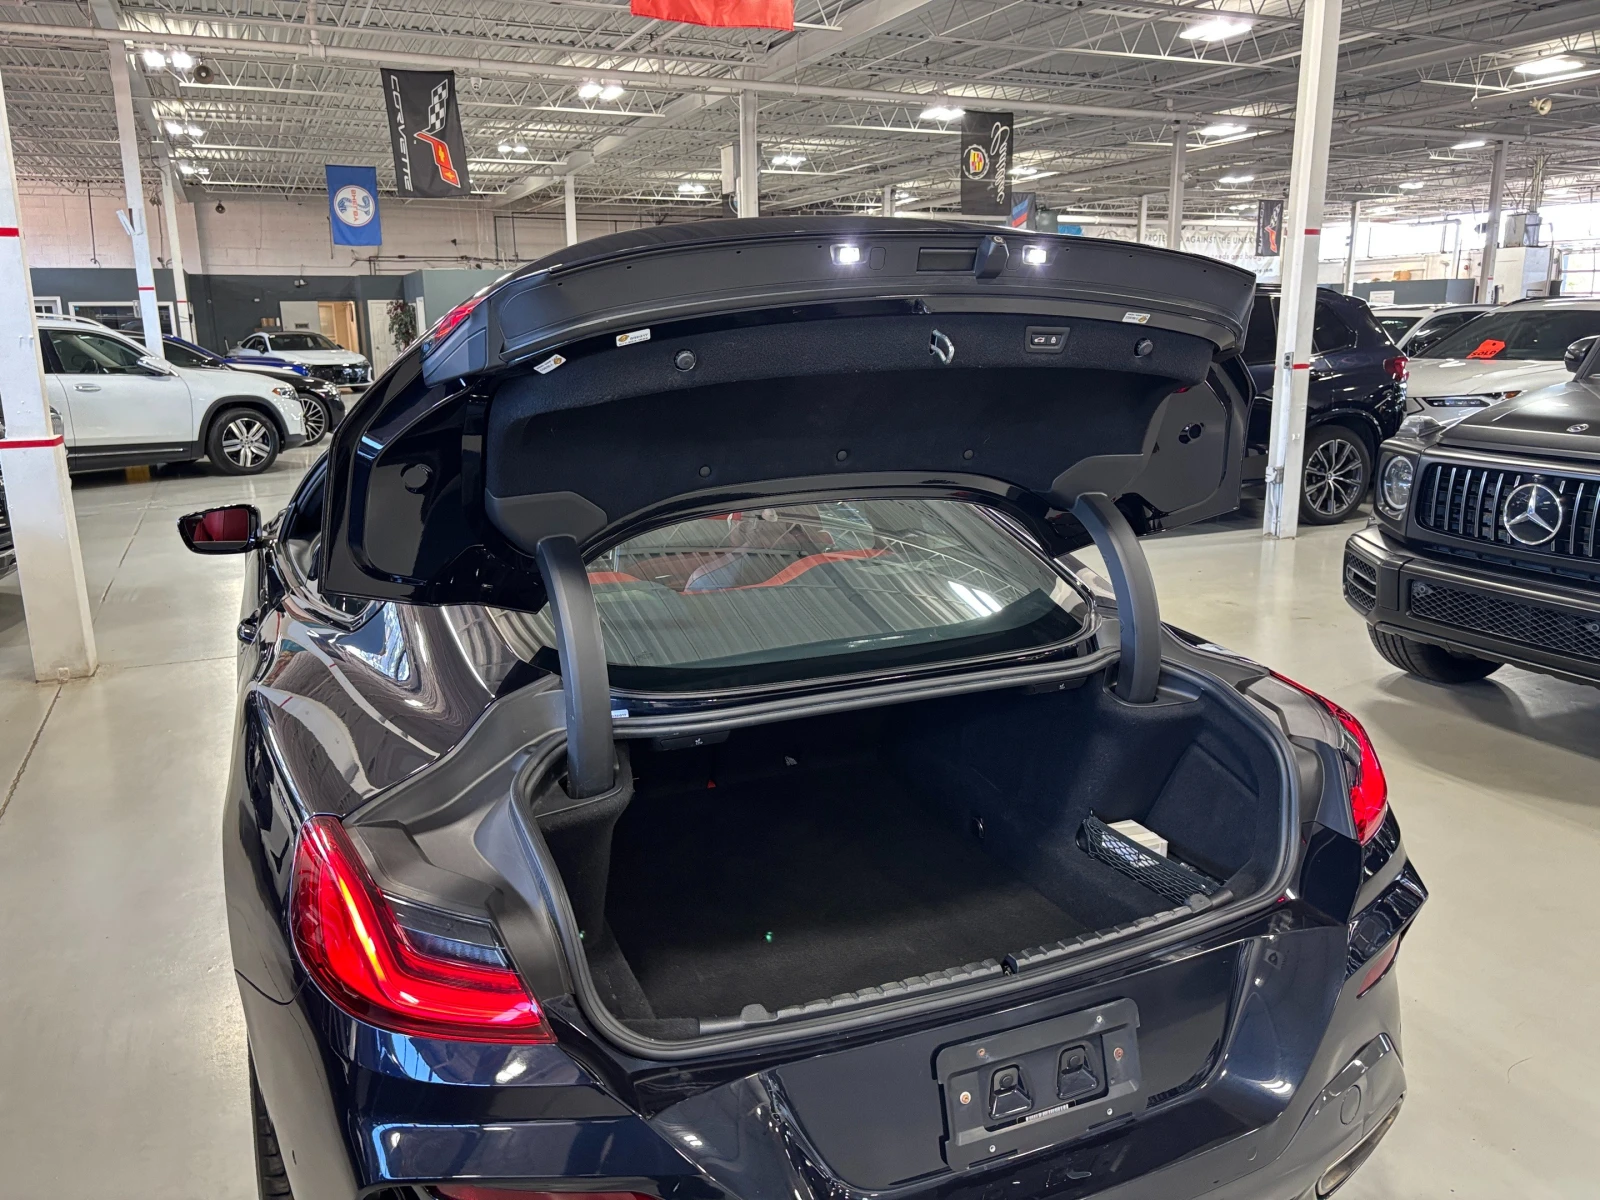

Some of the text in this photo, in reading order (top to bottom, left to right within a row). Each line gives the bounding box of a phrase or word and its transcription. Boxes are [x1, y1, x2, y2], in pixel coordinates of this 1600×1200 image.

[390, 74, 413, 192] CORVETTE
[350, 189, 359, 222] SHELBY
[1185, 236, 1217, 245] AGAINST
[1218, 236, 1231, 245] THE
